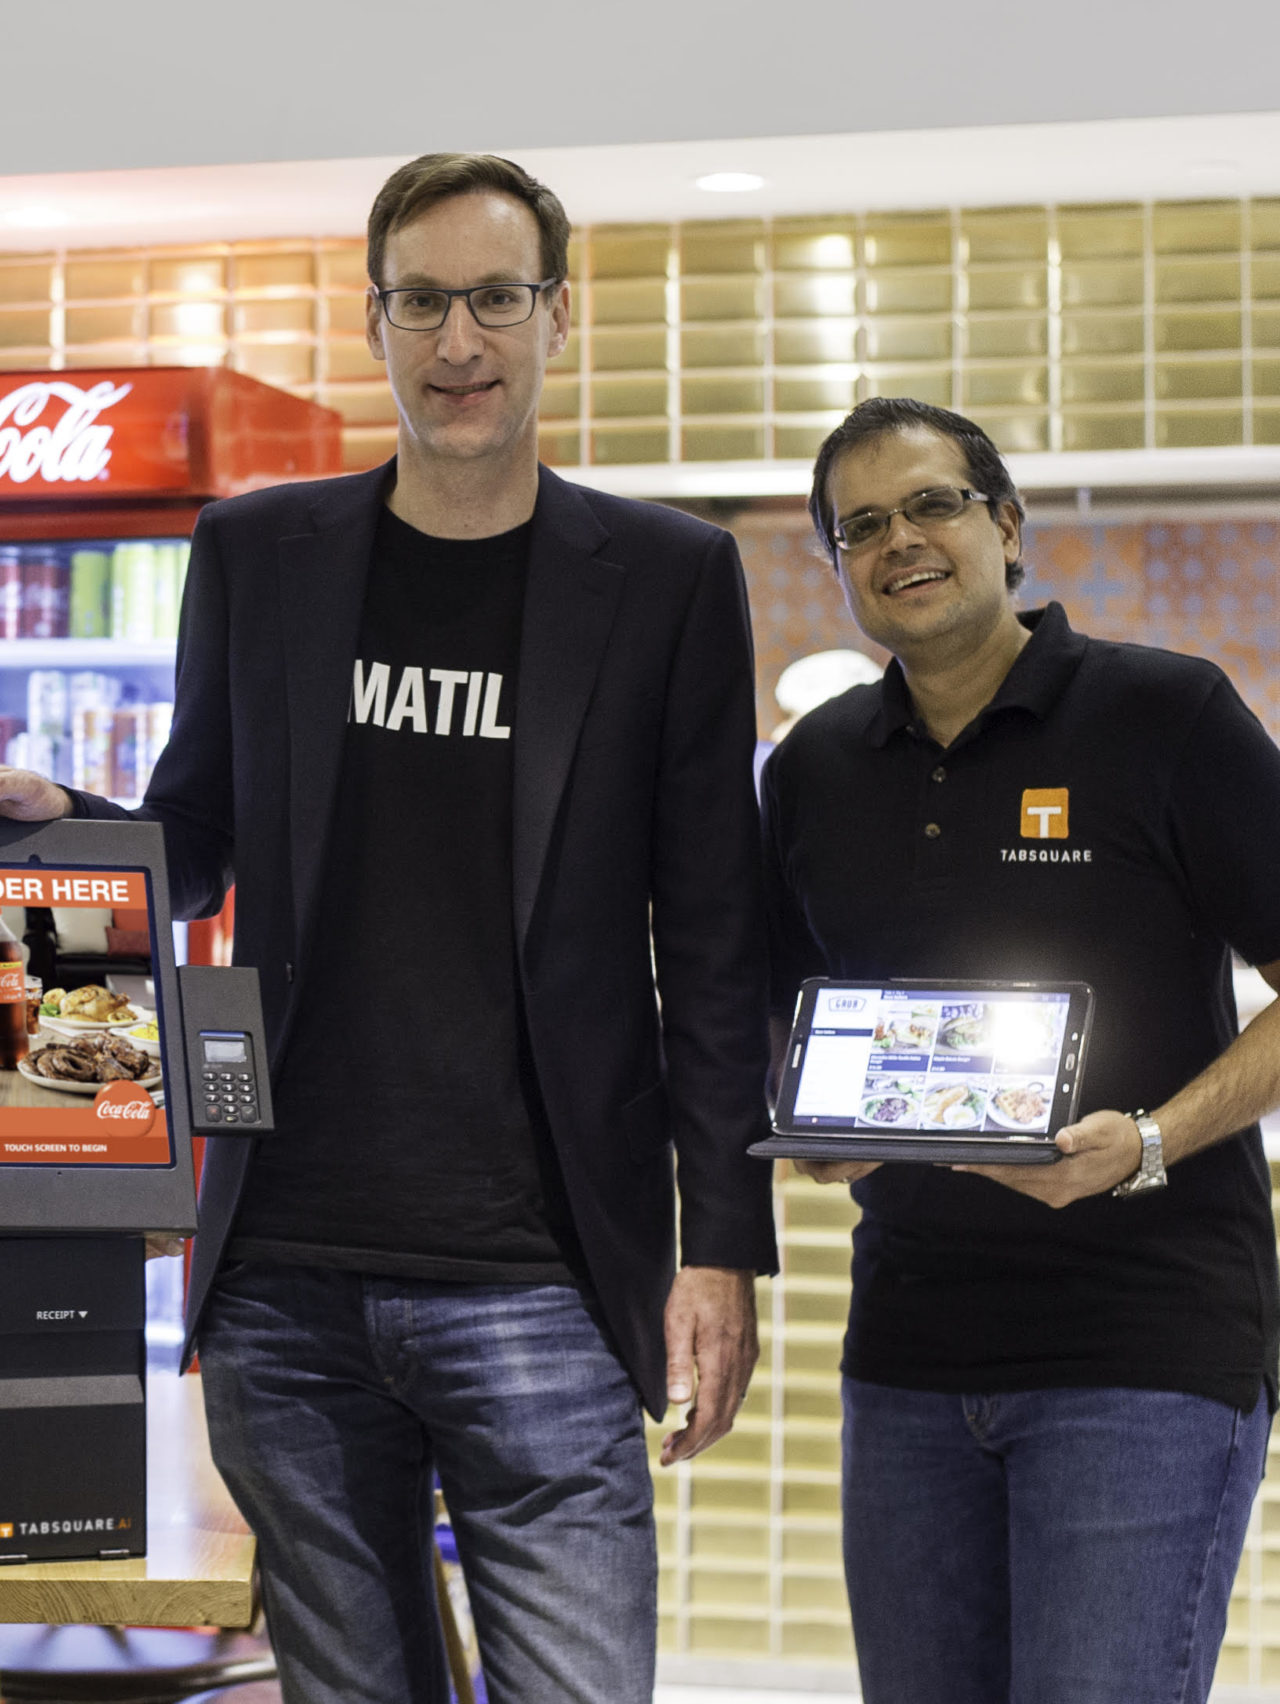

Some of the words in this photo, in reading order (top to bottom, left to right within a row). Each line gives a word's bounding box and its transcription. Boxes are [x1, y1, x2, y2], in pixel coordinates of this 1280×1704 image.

[1027, 806, 1062, 838] T
[1000, 848, 1092, 863] TABSQUARE
[51, 879, 130, 902] HERE
[96, 1100, 152, 1119] Coca-Cola
[4, 1143, 33, 1152] TOUCH
[34, 1143, 67, 1152] SCREEN
[68, 1143, 80, 1152] TO
[81, 1143, 108, 1152] BEGIN
[36, 1310, 75, 1320] RECEIPT
